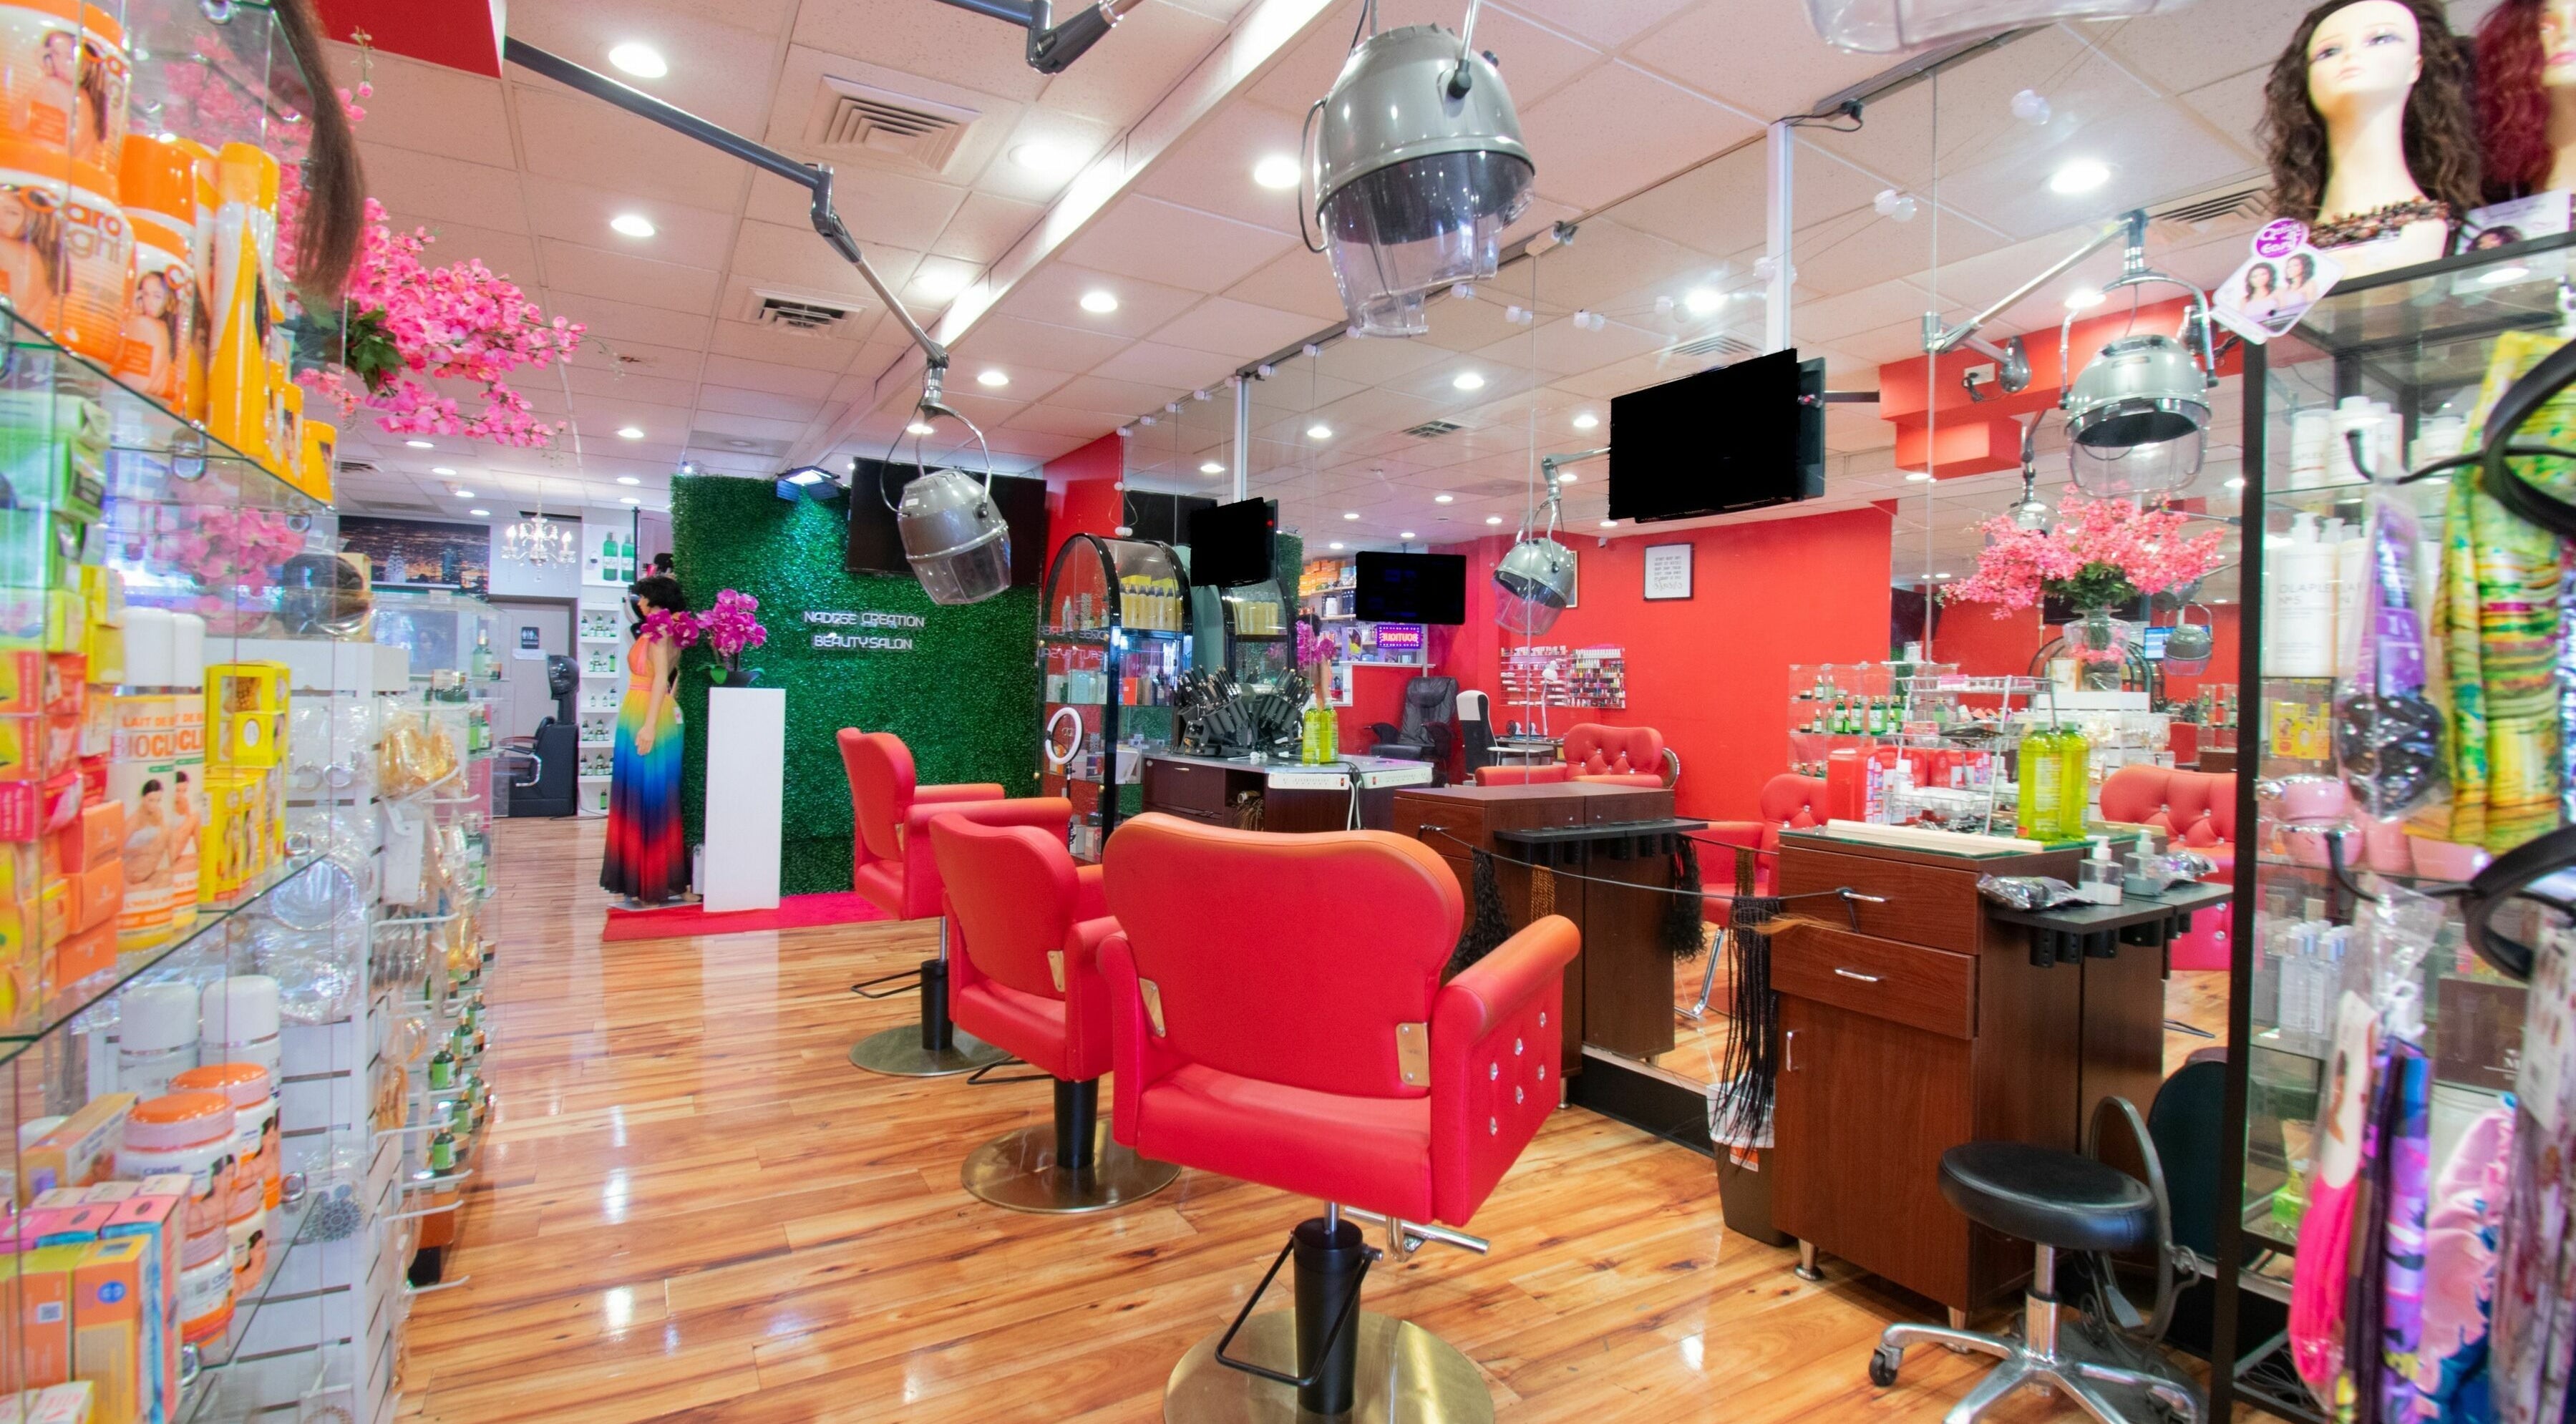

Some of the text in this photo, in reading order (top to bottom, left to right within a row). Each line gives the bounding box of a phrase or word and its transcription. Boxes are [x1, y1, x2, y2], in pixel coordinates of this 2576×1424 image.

[2278, 583, 2331, 594] OLAPLE
[861, 613, 925, 628] CREATION
[814, 635, 913, 650] BEAUTY SALON
[123, 716, 152, 728] LAIT
[111, 732, 175, 758] BIOCL
